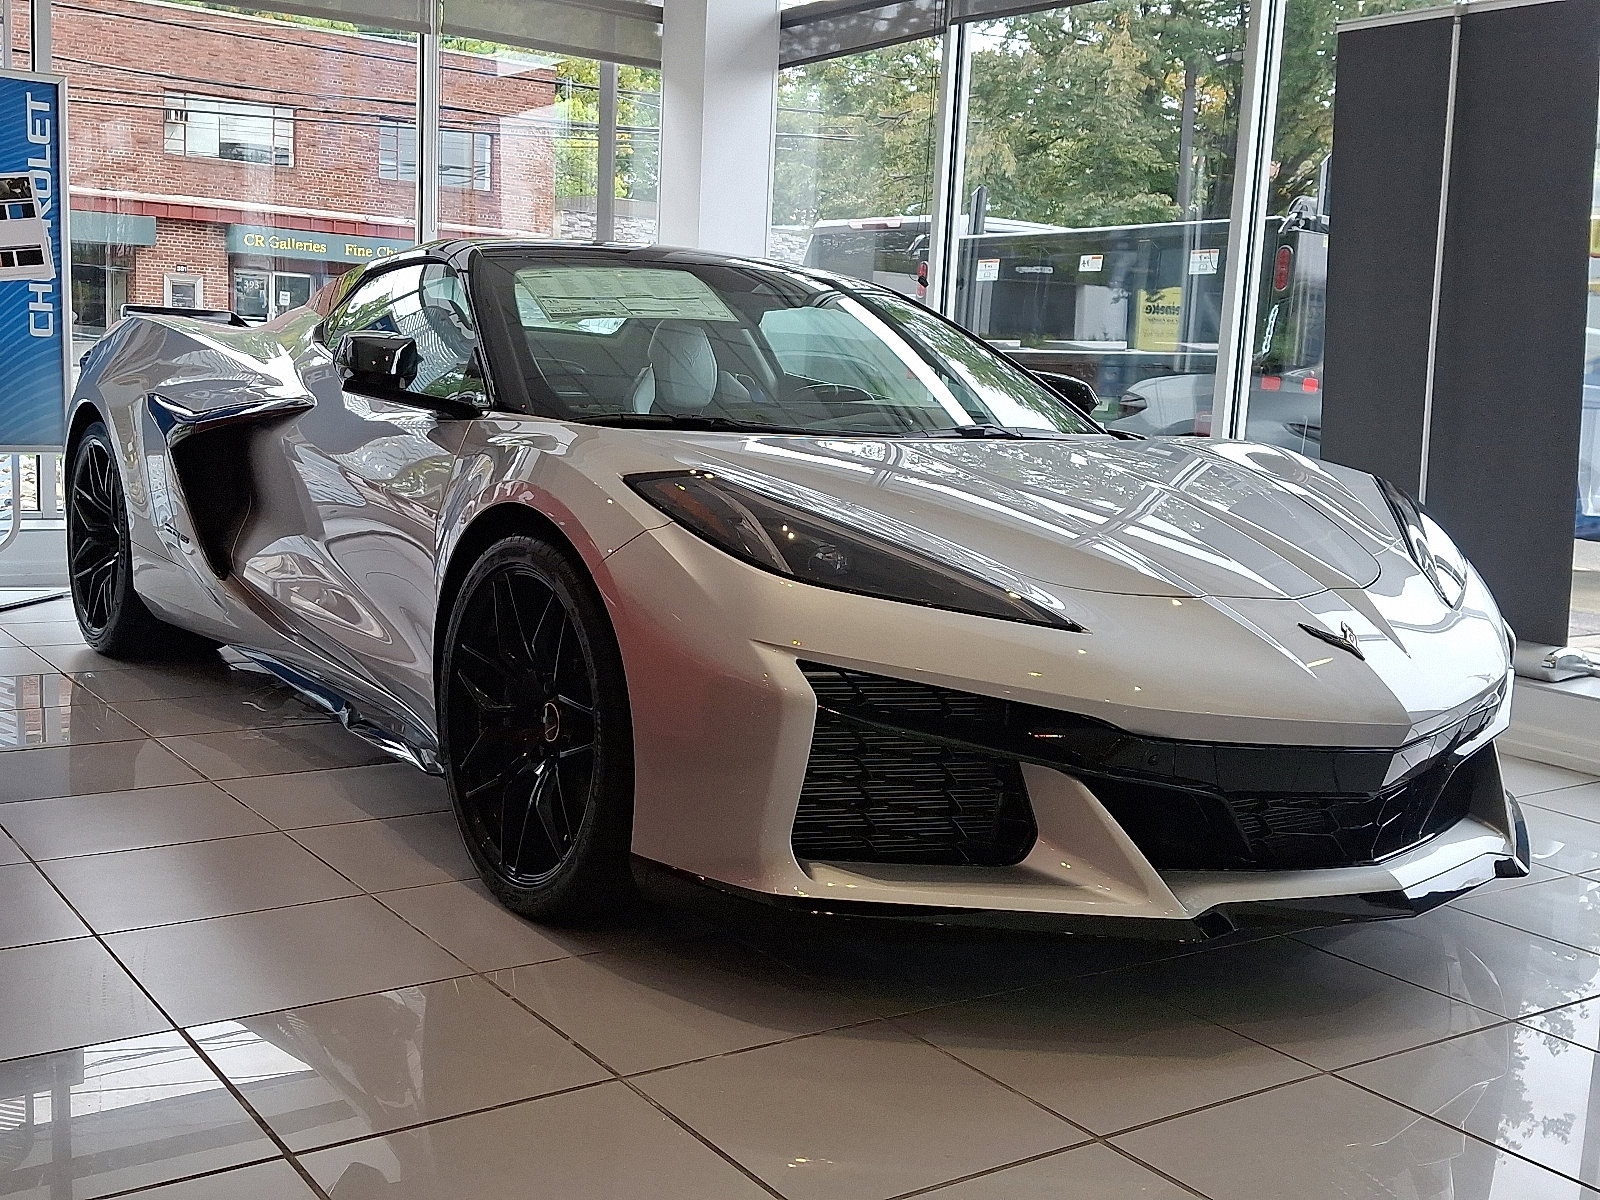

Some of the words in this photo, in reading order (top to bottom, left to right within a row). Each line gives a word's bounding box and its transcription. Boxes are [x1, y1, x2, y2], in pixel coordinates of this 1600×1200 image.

[26, 91, 53, 338] CHOLET
[243, 233, 265, 247] CR
[269, 236, 327, 253] Galleries
[344, 243, 373, 257] Fine
[243, 279, 260, 290] 393
